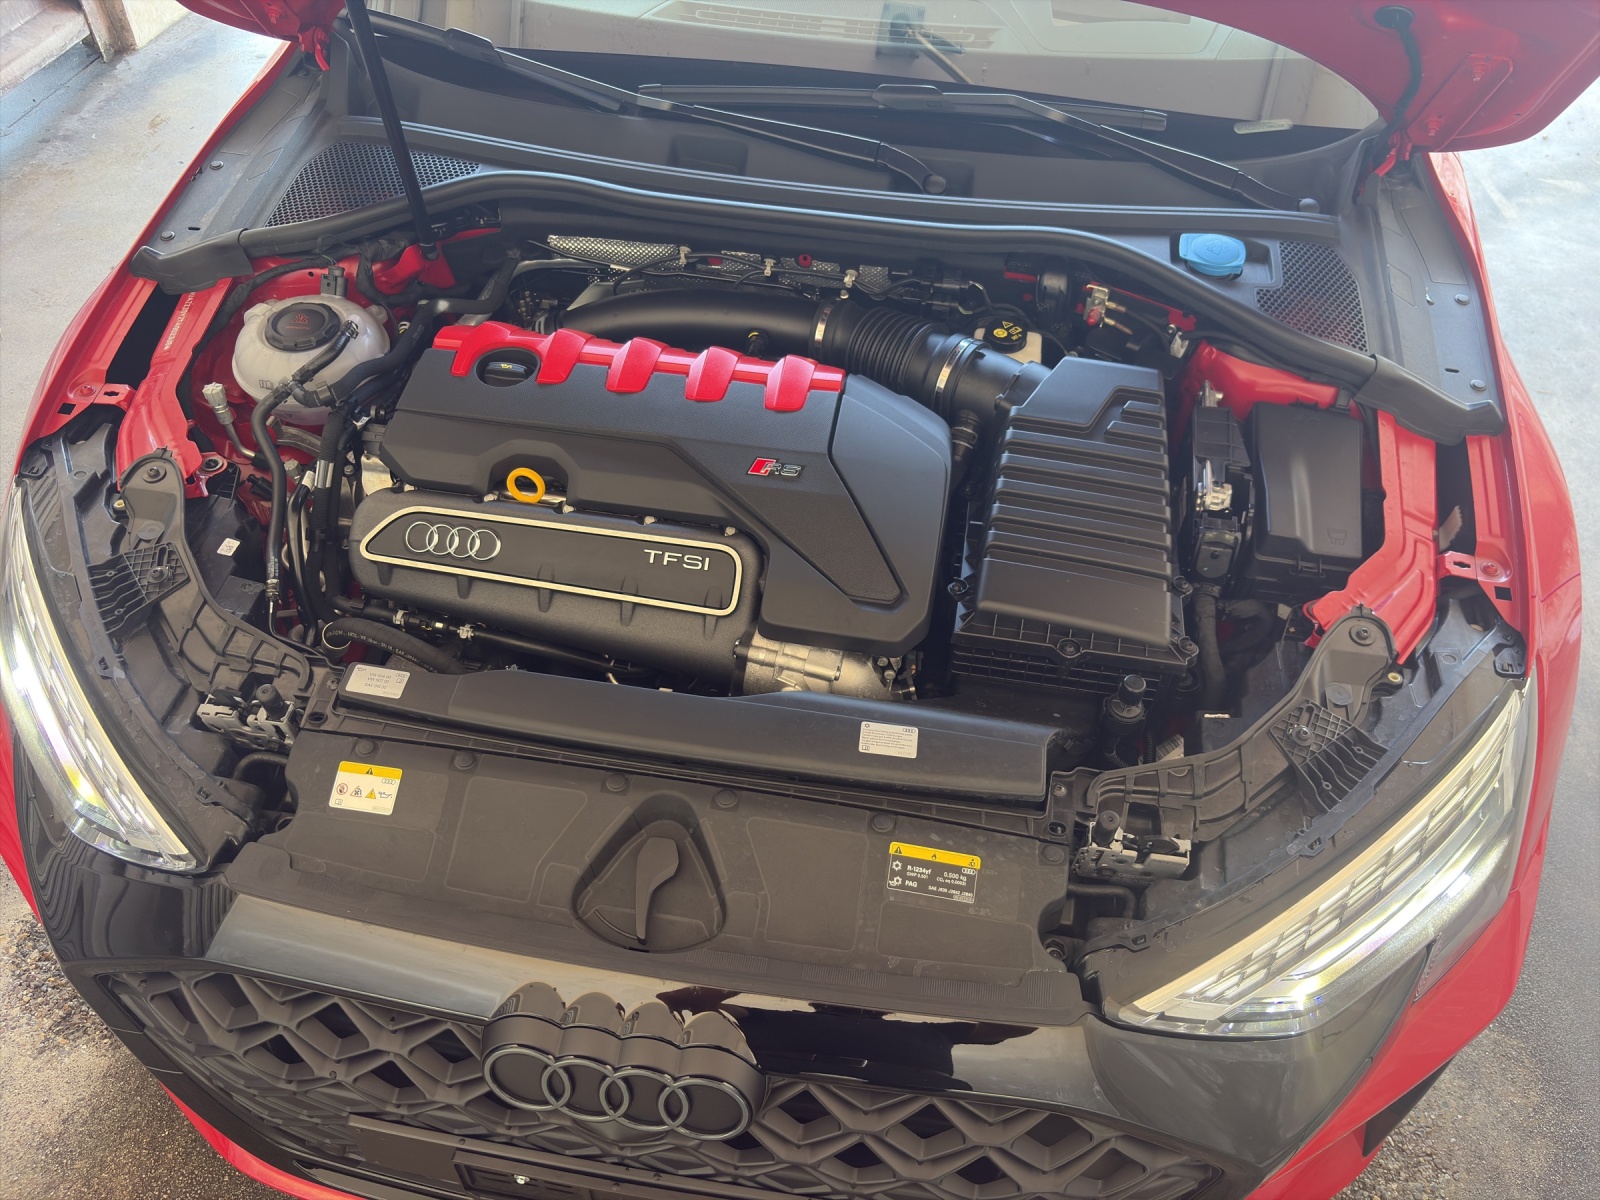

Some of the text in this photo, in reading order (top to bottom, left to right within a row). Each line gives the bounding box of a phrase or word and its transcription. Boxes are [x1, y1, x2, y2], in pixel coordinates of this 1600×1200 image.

[752, 458, 801, 476] RS
[644, 549, 710, 571] TFSI
[906, 864, 932, 875] R-1234yf
[943, 871, 967, 882] 0.500 kg
[905, 879, 918, 888] PAG
